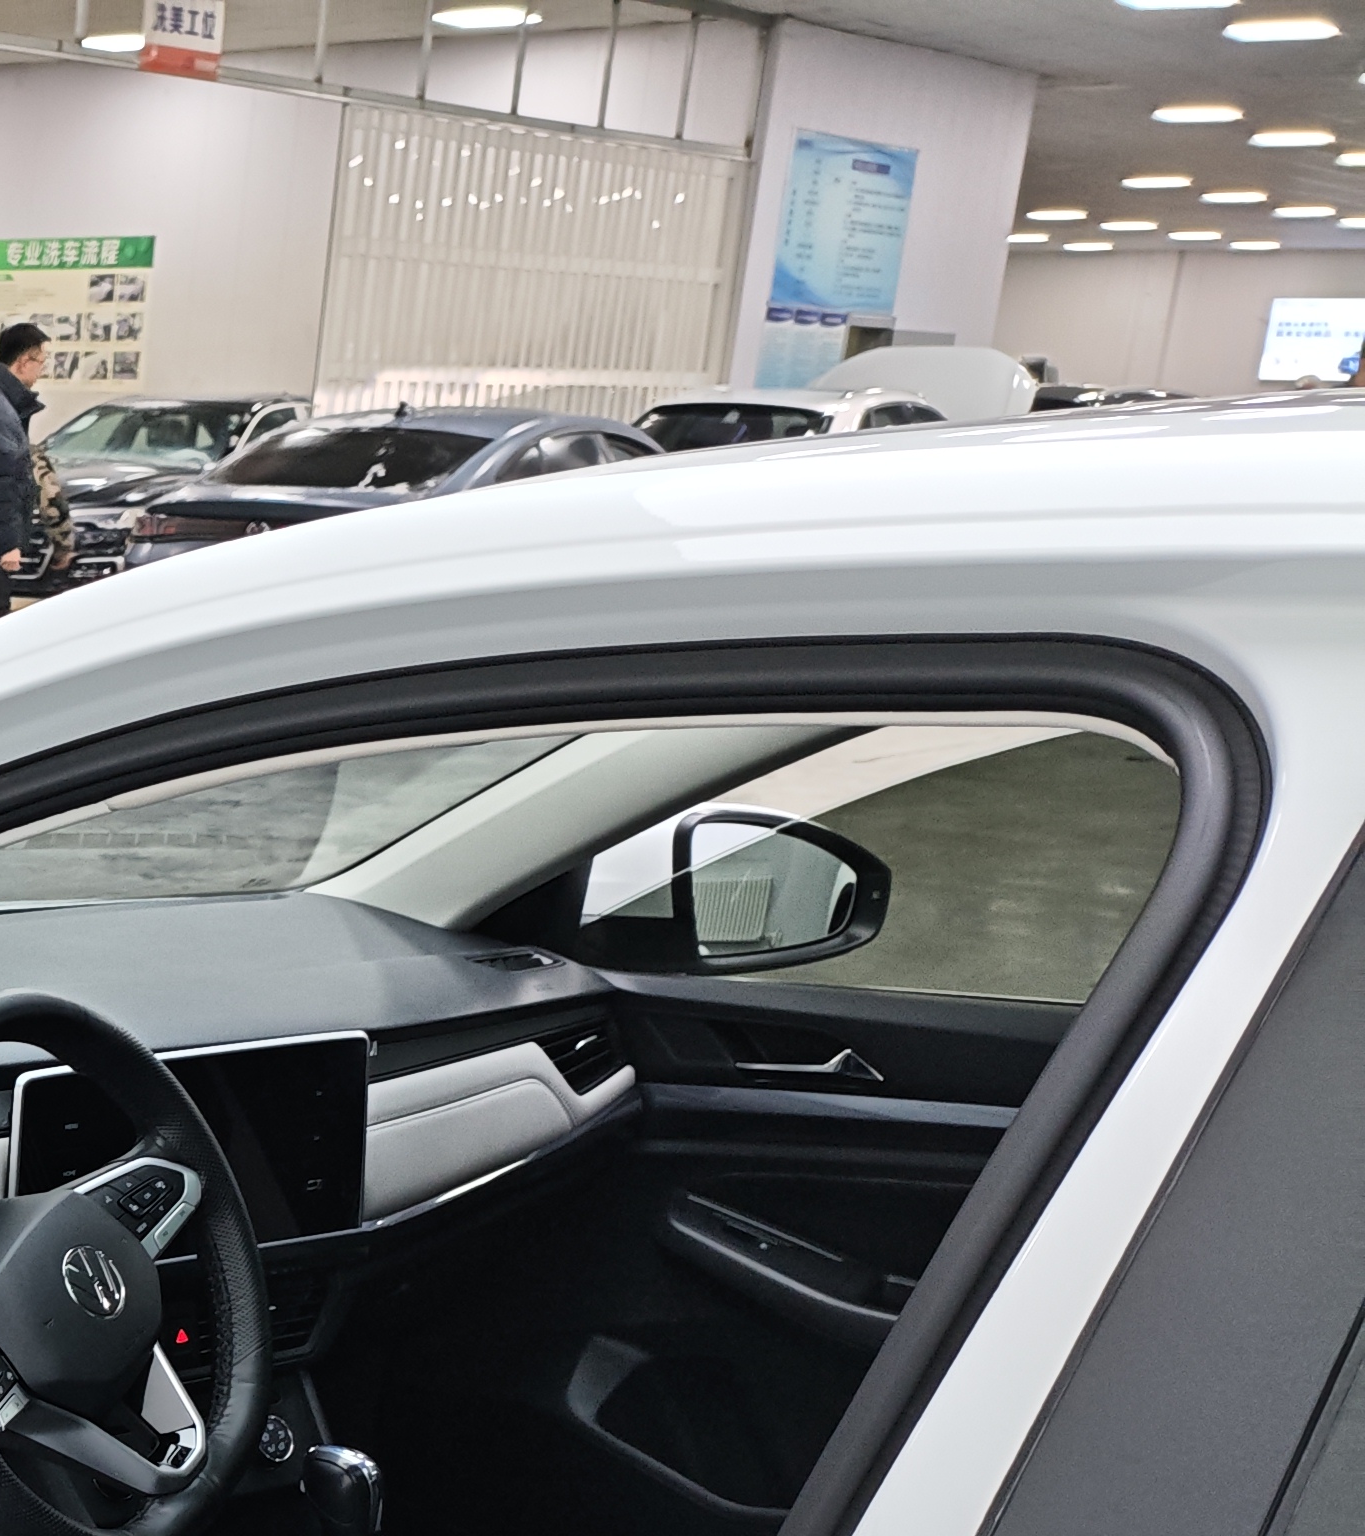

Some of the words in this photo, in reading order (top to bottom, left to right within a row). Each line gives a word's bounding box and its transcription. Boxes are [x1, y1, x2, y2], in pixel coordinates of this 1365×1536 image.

[6, 239, 120, 266] 专业洗车流程
